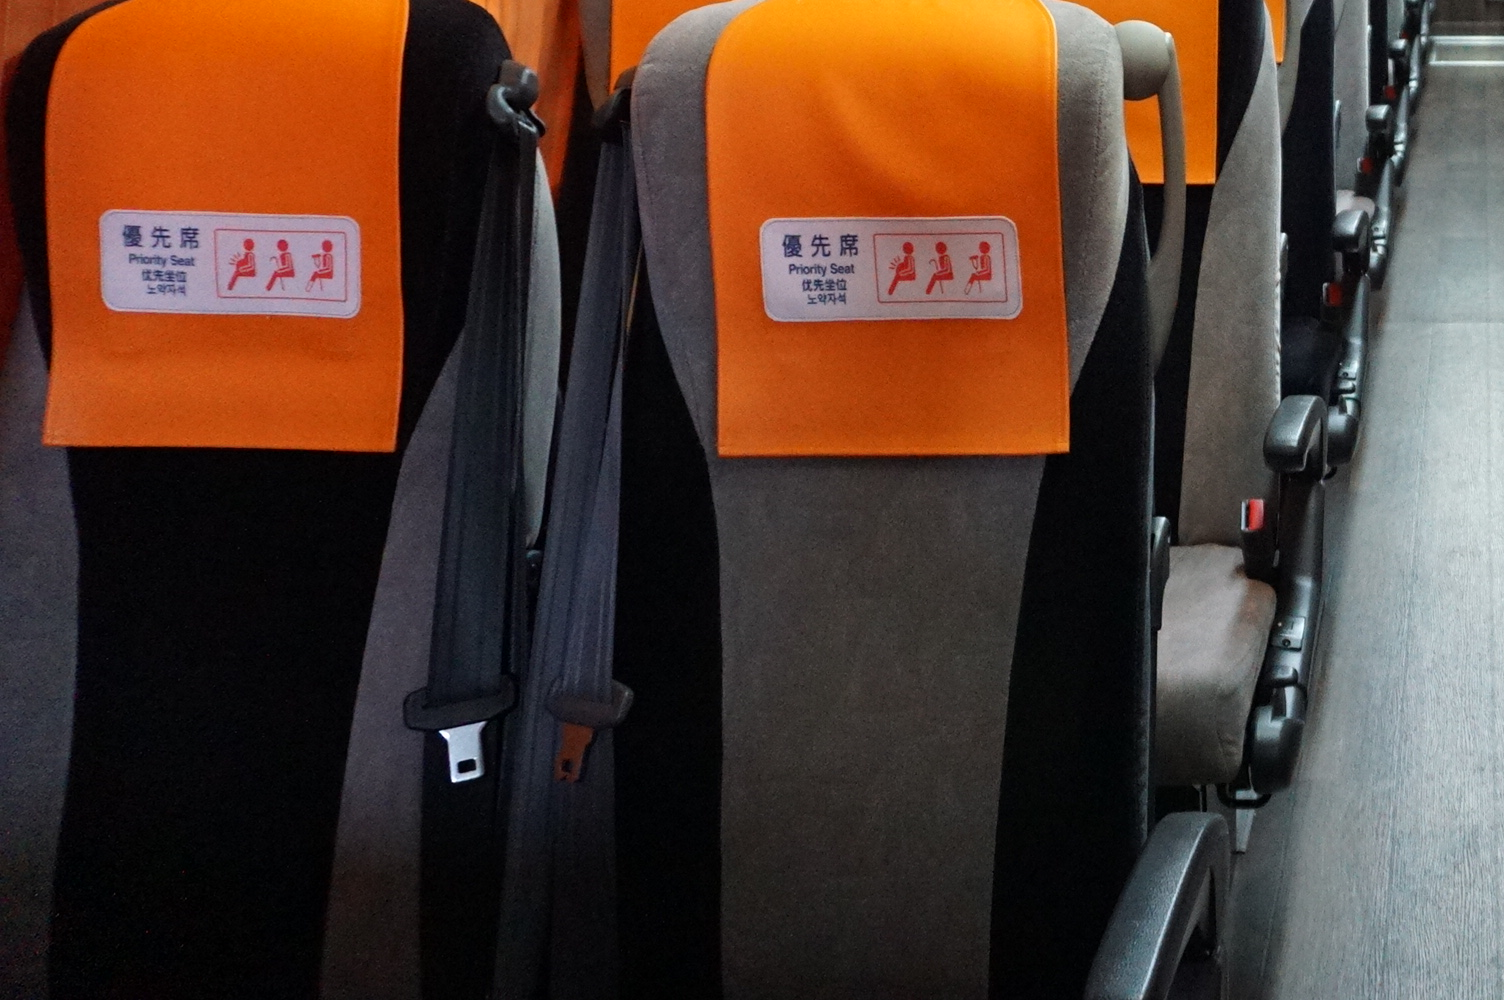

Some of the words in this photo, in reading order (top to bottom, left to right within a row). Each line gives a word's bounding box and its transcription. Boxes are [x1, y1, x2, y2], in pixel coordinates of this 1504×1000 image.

[122, 225, 200, 250] 優先席
[782, 234, 859, 258] 優先席
[128, 253, 167, 268] Priority
[170, 255, 195, 267] Seat
[789, 263, 827, 278] Priority
[830, 263, 855, 274] Seat
[802, 279, 847, 292] 优先坐位
[807, 293, 847, 305] 노약자석
